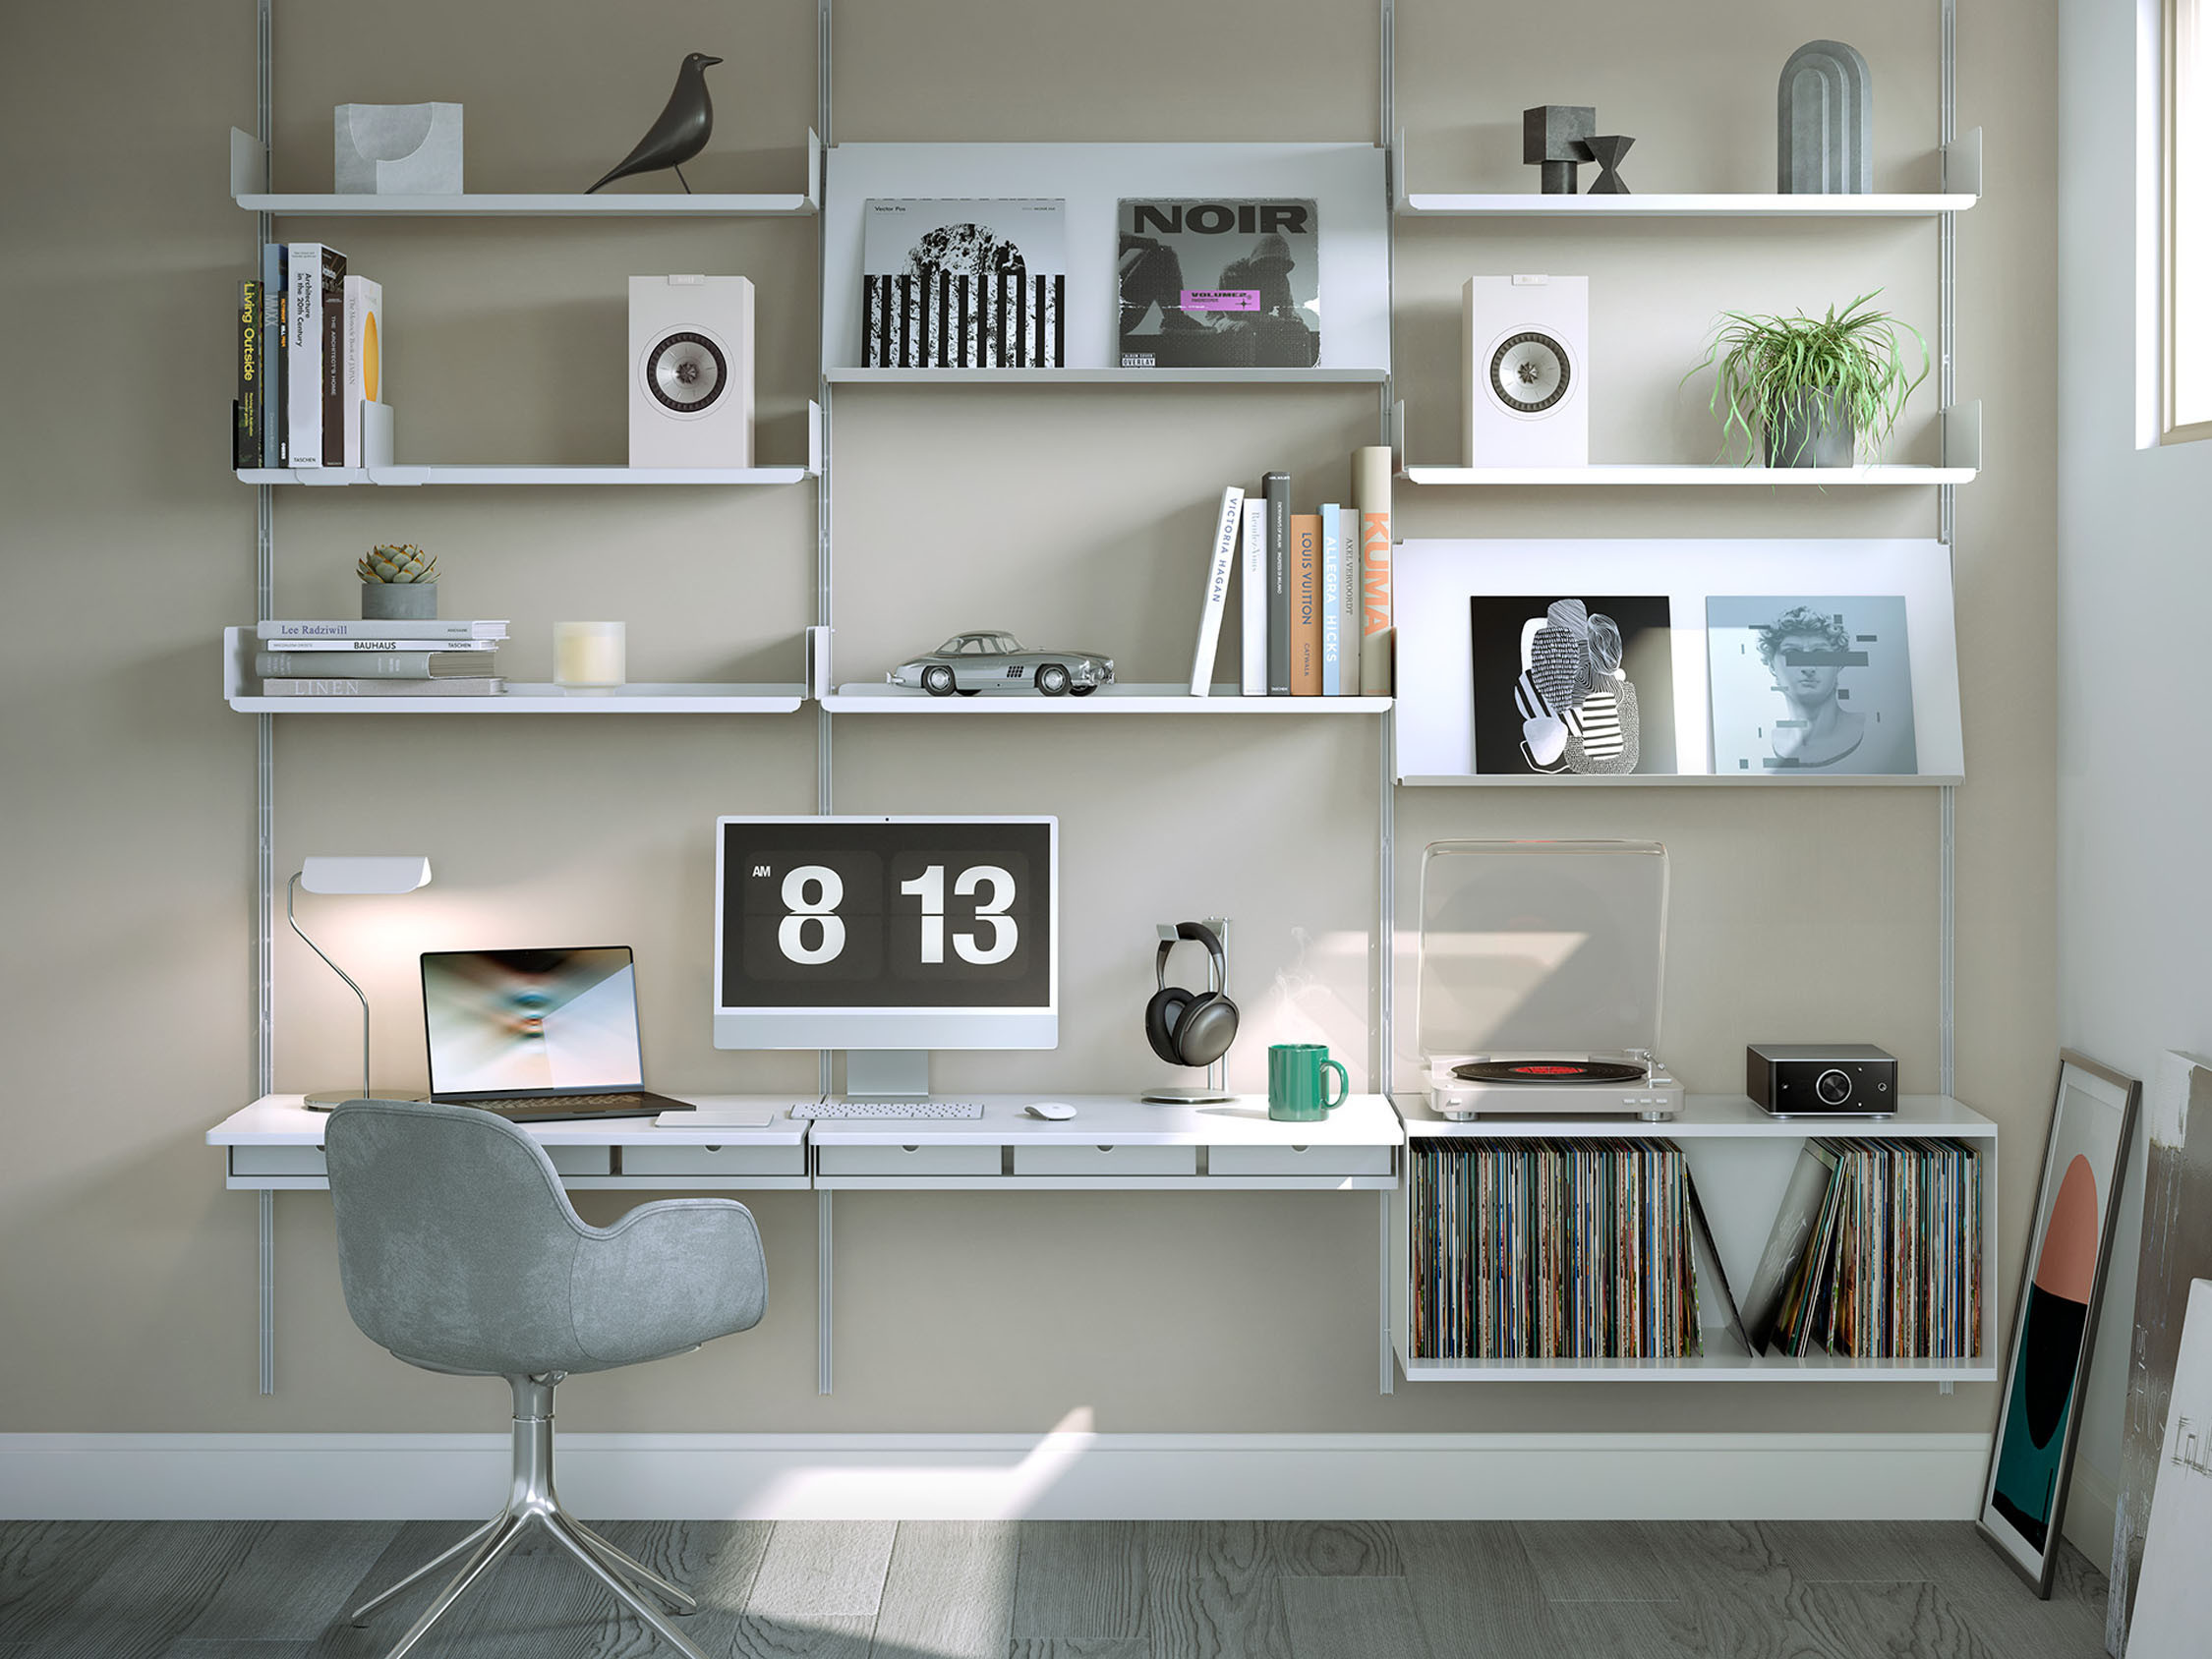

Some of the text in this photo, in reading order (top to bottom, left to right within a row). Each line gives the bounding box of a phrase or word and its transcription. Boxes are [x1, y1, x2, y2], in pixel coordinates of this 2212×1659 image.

[1134, 204, 1308, 235] NOIR
[241, 283, 255, 381] Living Outside
[264, 293, 278, 327] MMXX
[295, 272, 305, 348] in the 20th Century
[347, 362, 356, 385] JAPAN
[1212, 497, 1238, 602] VICTORIA HAGAN
[1302, 532, 1312, 625] LOUIS VUITTON
[1364, 512, 1389, 637] KUMA
[281, 625, 347, 635] Lee Radziwill
[1326, 536, 1337, 662] ALLEGRA HICKS
[295, 680, 359, 696] LINEN
[752, 865, 771, 878] AM
[778, 865, 1019, 965] 8 13
